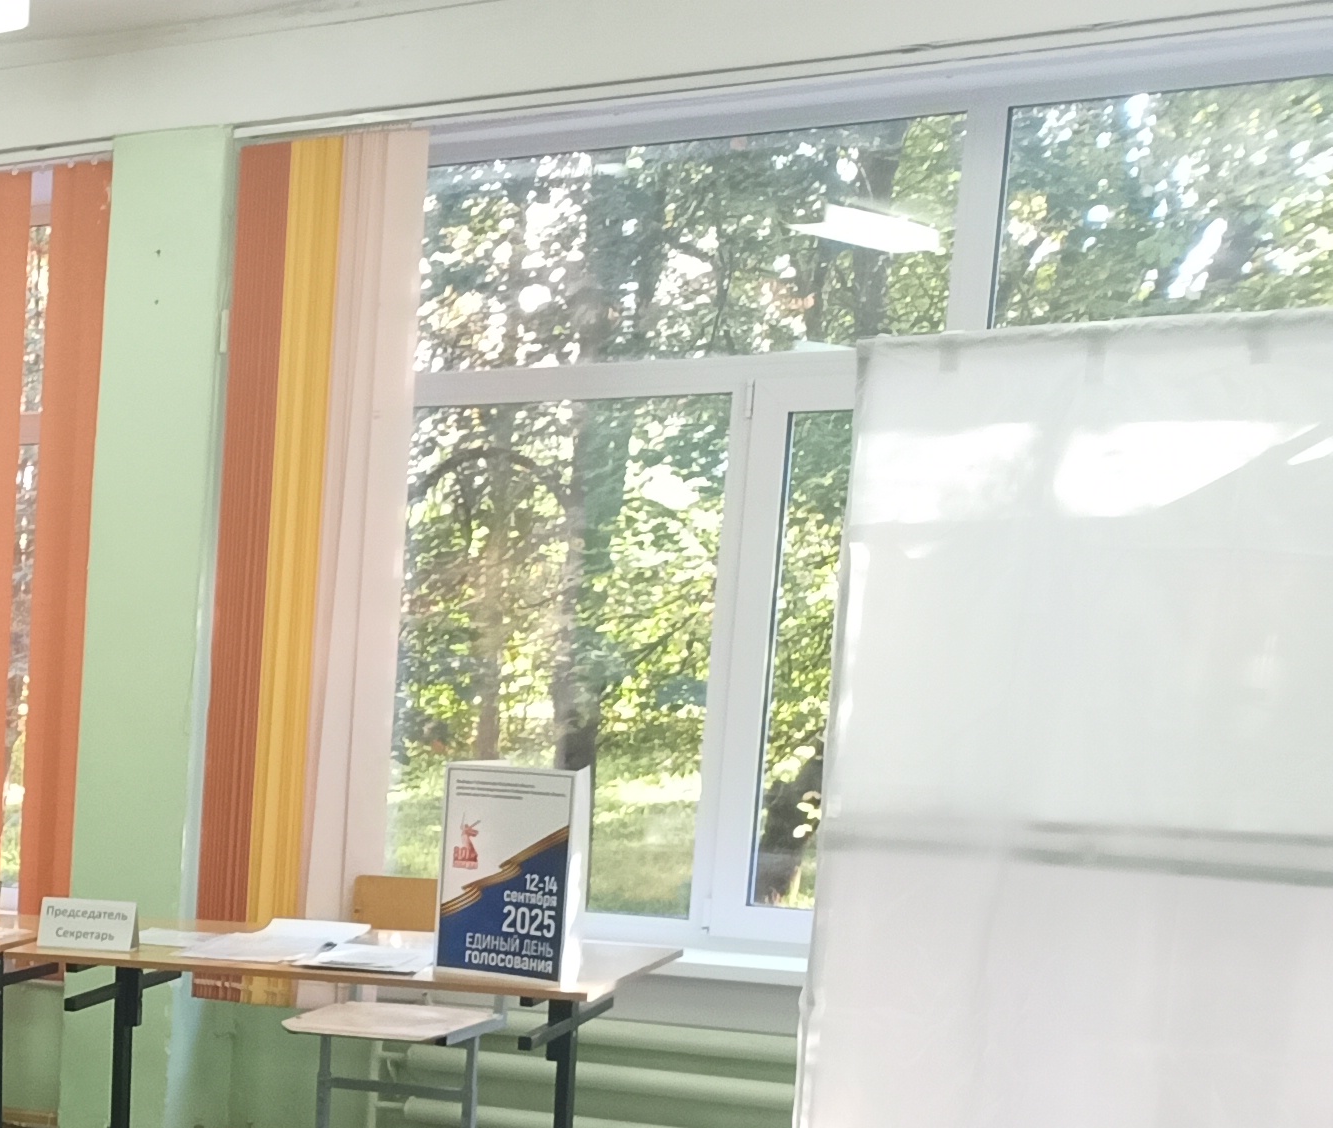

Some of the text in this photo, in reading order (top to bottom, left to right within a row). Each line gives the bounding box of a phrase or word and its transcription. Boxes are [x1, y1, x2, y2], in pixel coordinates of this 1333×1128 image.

[525, 873, 558, 893] 12-14
[503, 890, 558, 908] сентября
[46, 905, 128, 921] Председатель
[501, 905, 556, 938] 2025
[55, 926, 115, 942] Секретарь
[465, 932, 553, 958] ЕДИНЫЙ ДЕНЬ
[464, 949, 553, 974] голосования
